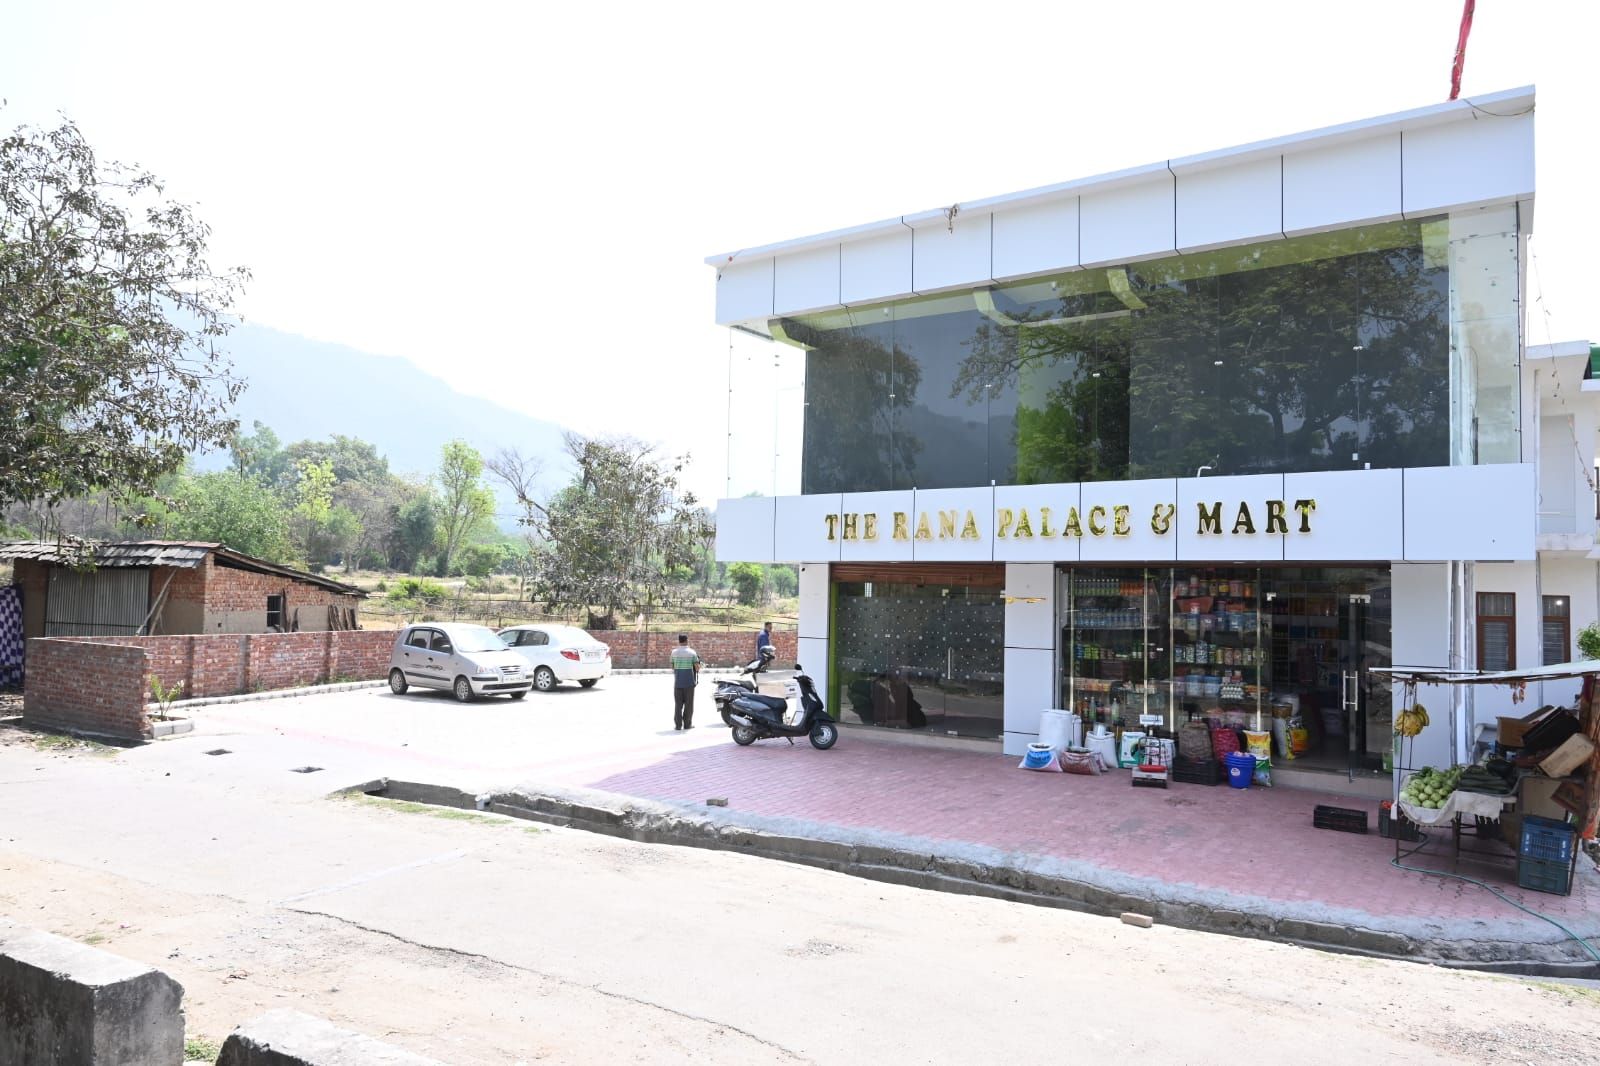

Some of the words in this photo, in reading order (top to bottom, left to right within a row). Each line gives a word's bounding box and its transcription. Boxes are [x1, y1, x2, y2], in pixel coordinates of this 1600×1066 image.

[825, 513, 877, 540] THE
[893, 510, 978, 540] RANA
[997, 505, 1130, 537] PALACE
[1151, 502, 1176, 534] &
[1197, 499, 1317, 534] MART
